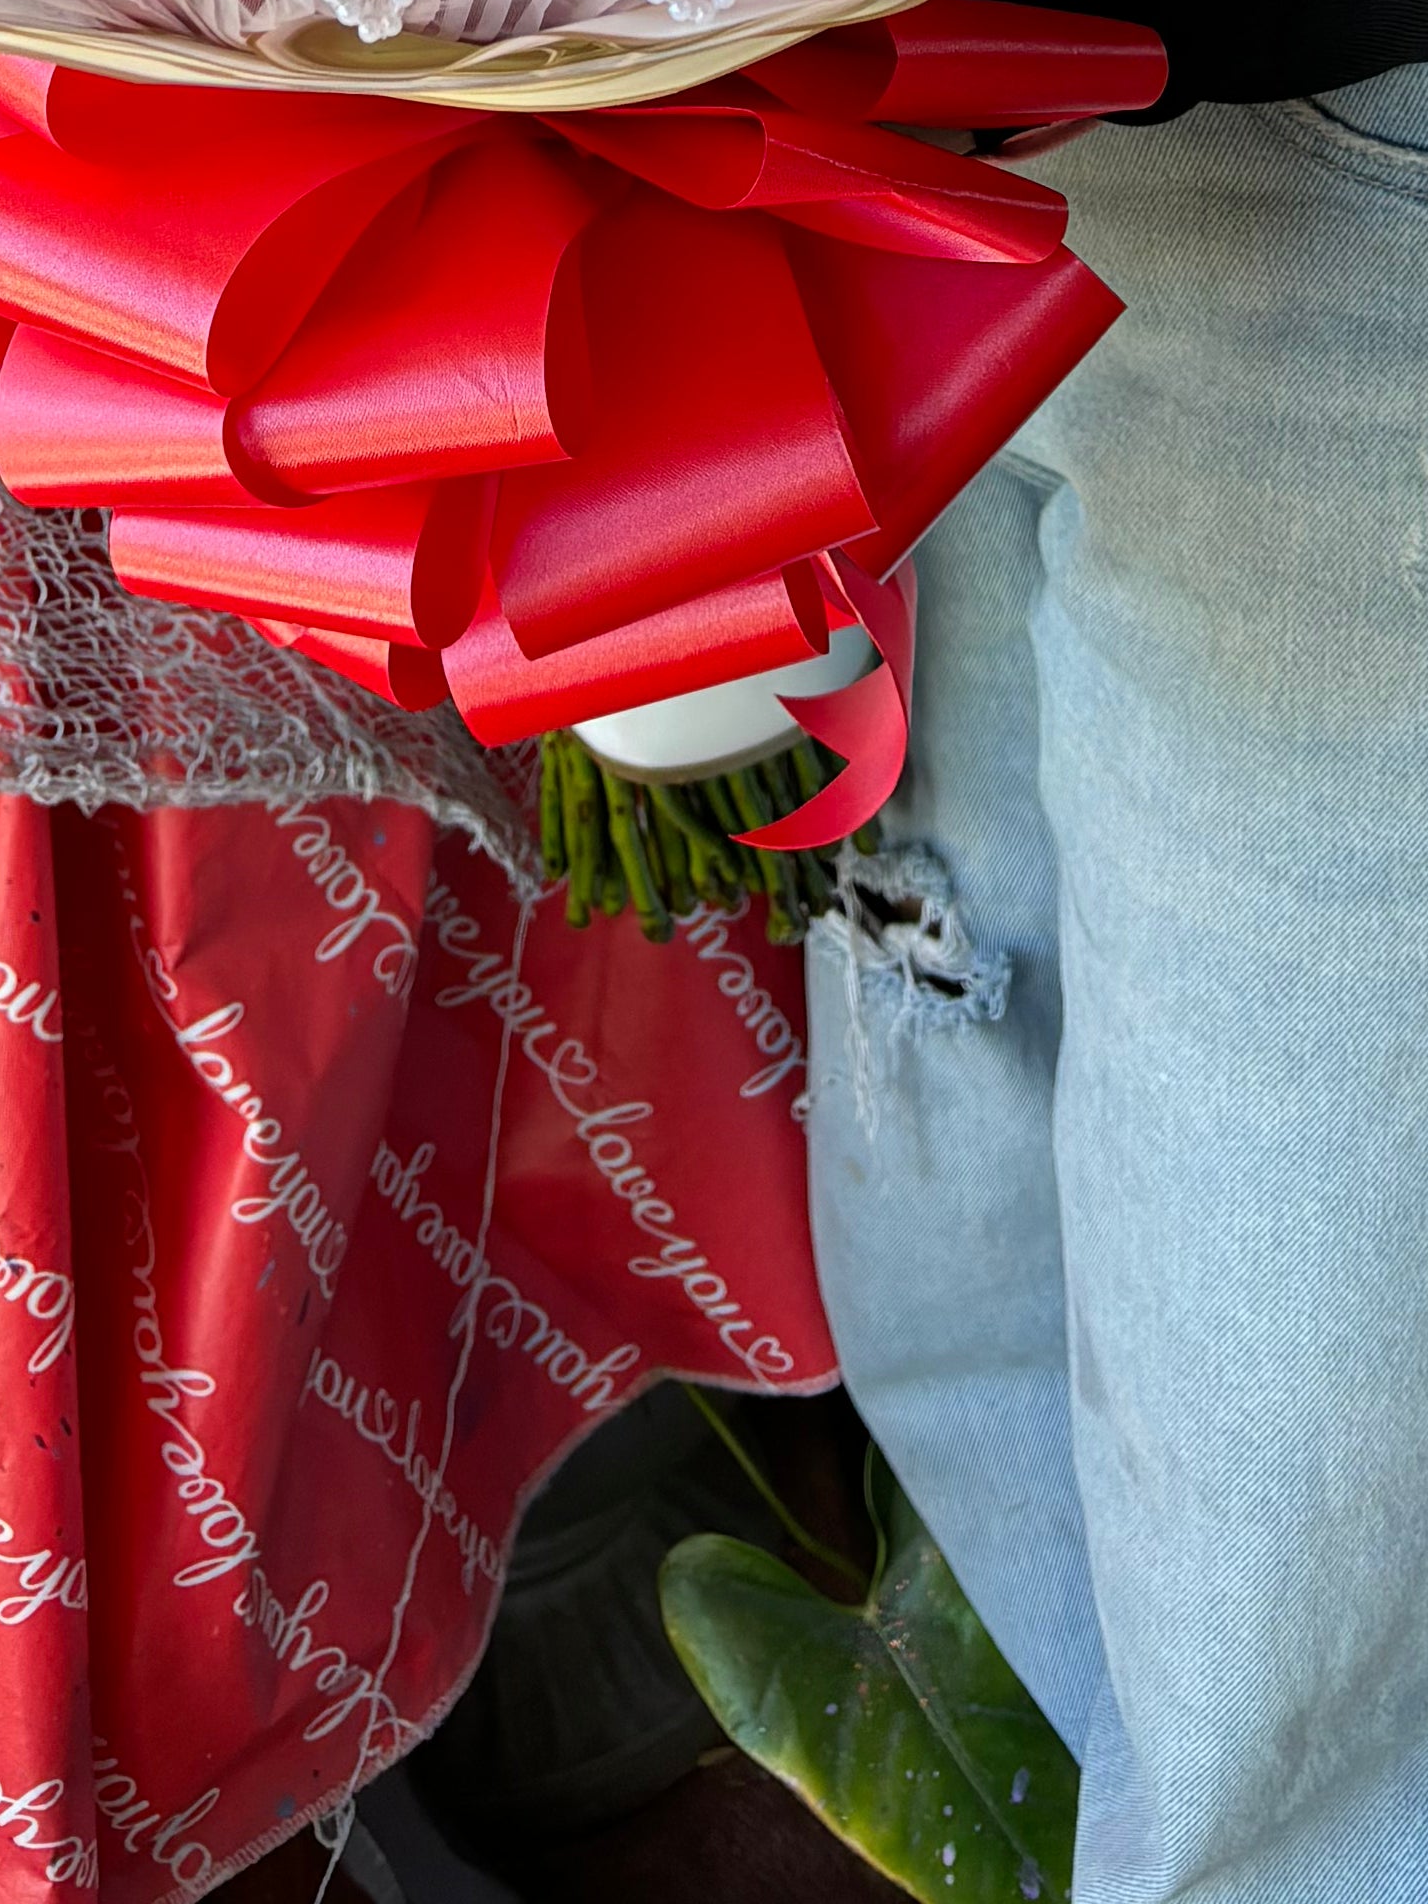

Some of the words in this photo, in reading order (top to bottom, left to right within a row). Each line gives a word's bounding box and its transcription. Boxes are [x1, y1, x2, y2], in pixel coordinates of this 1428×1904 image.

[291, 814, 381, 963] love
[176, 1001, 282, 1162] love
[231, 1152, 340, 1258] you
[435, 952, 558, 1058] you
[575, 1101, 675, 1232] love
[627, 1237, 754, 1357] you
[132, 1260, 217, 1412] you
[521, 1305, 641, 1411] you
[160, 1432, 261, 1589] love
[459, 1512, 506, 1596] yo
